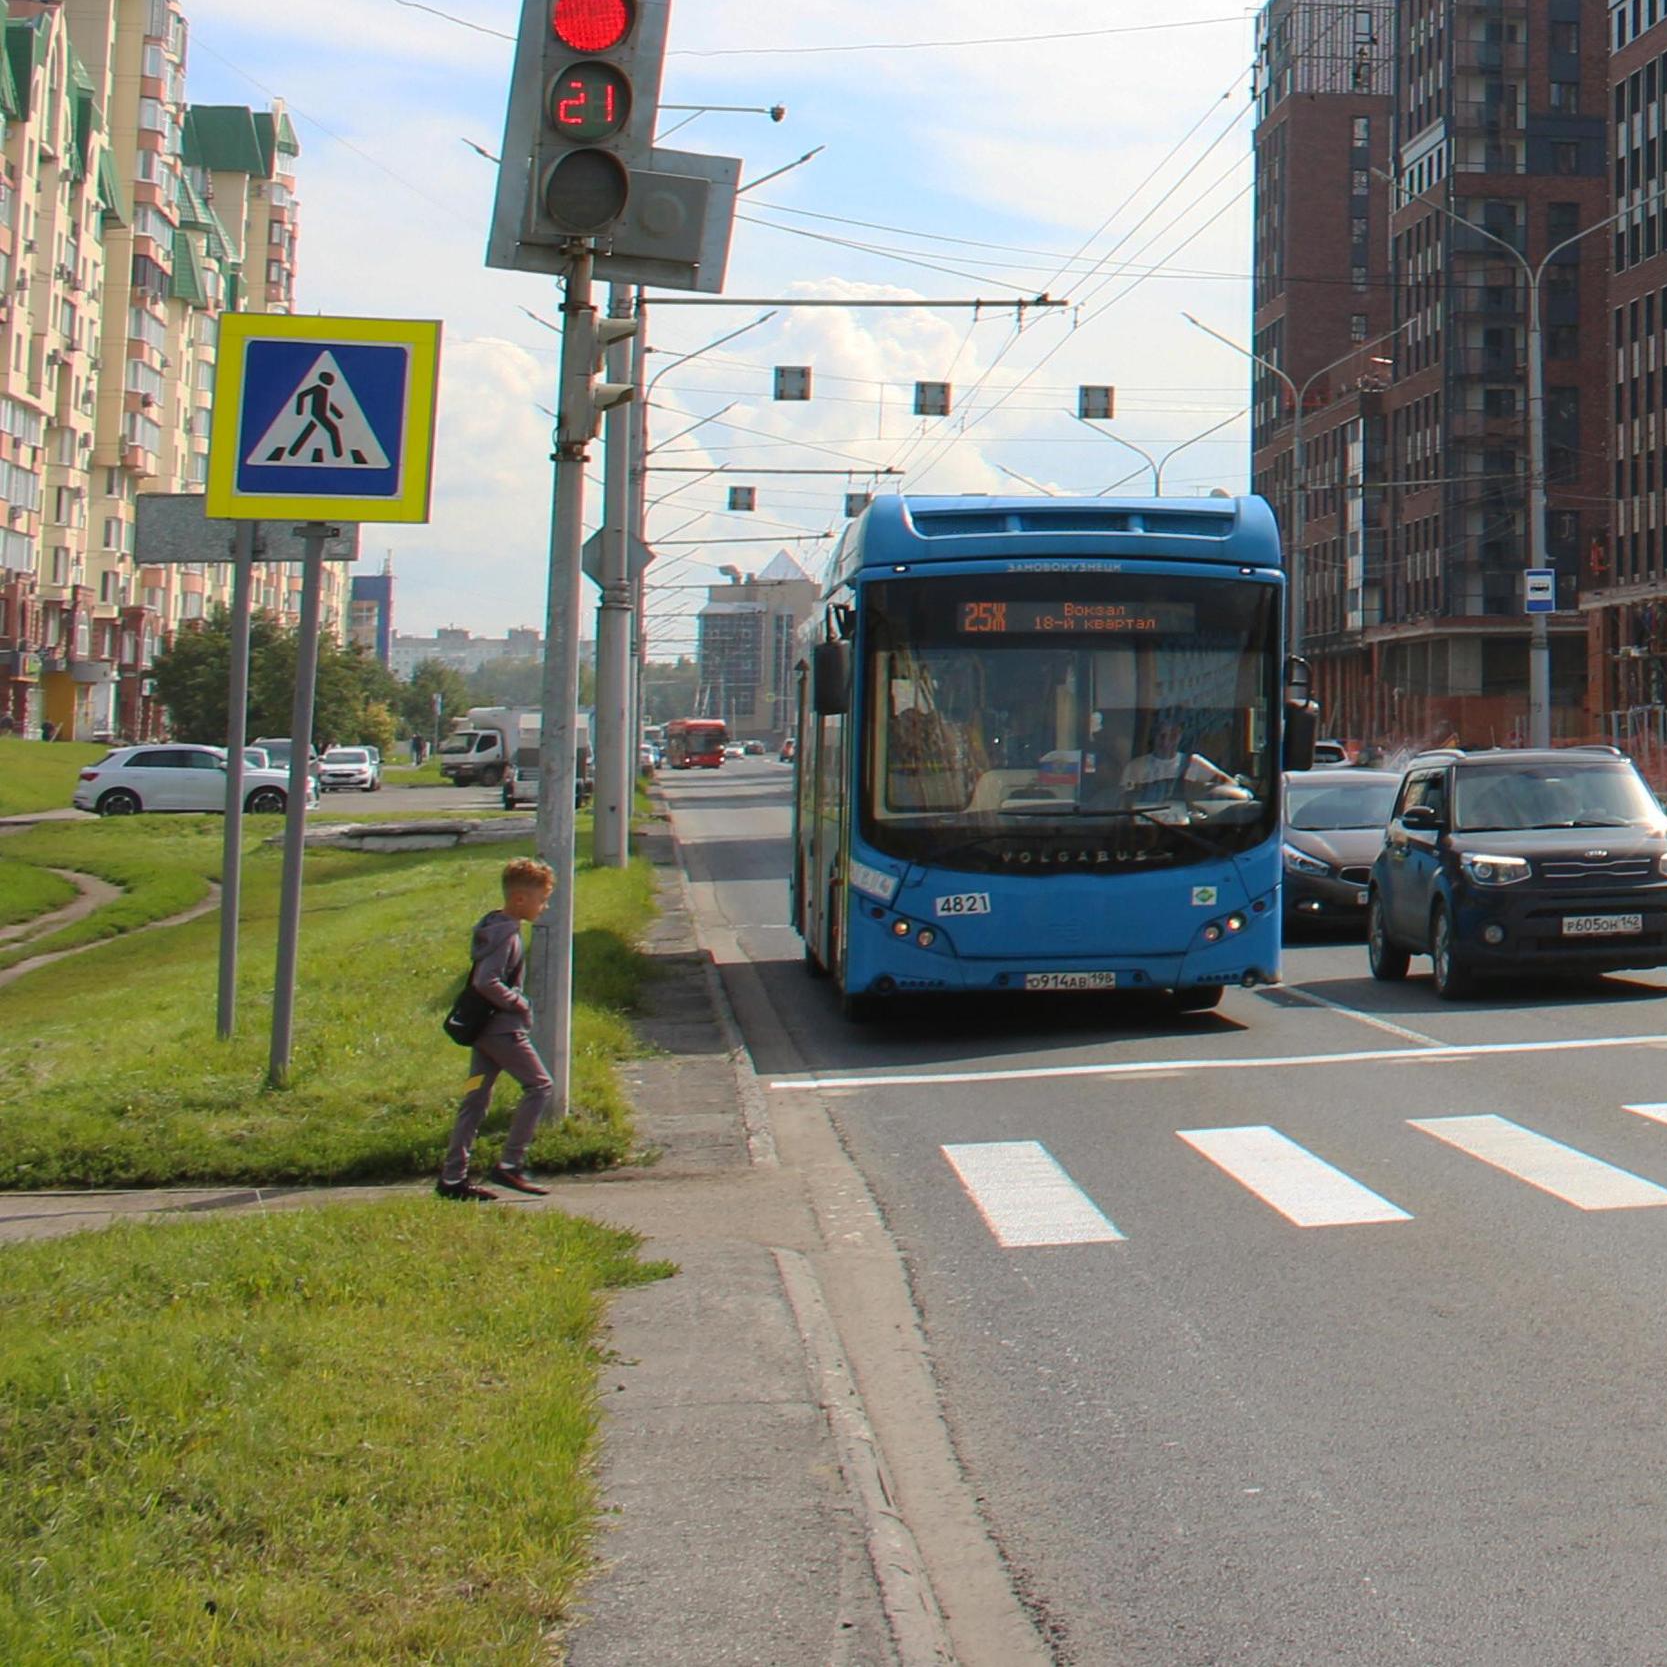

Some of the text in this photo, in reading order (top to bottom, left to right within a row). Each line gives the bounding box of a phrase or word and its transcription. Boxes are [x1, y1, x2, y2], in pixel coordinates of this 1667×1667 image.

[560, 81, 614, 125] 21
[964, 602, 1006, 632] 25Ж
[1064, 602, 1125, 617] Вокзал
[1034, 616, 1156, 630] 18-й квартал
[1002, 850, 1147, 864] VOLGABUS
[940, 894, 989, 913] 4821
